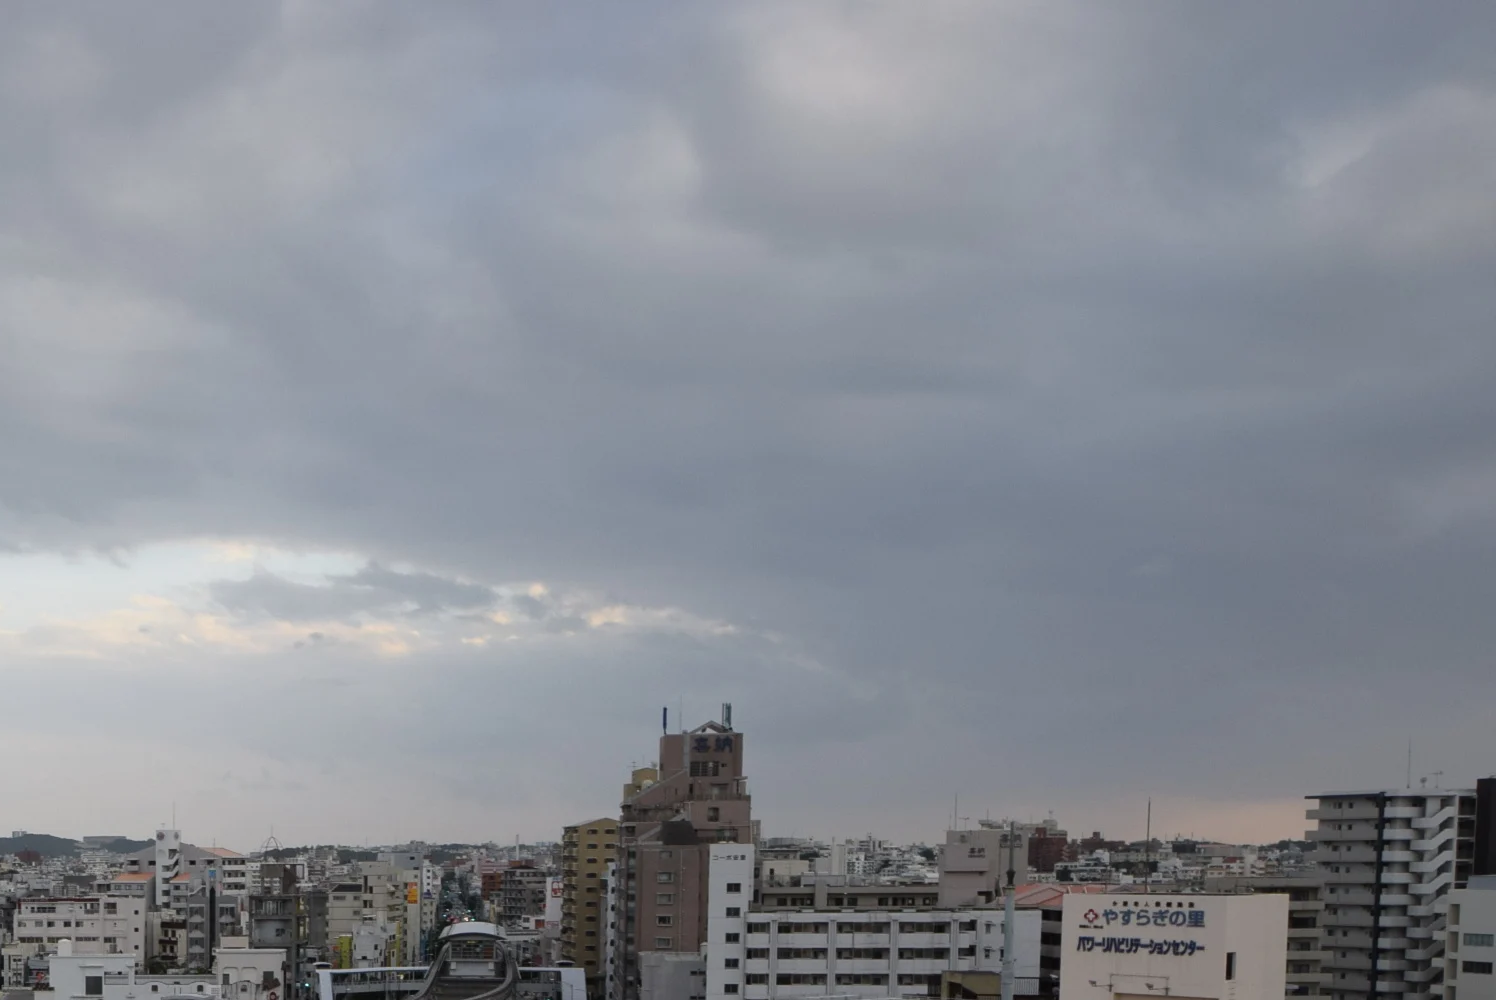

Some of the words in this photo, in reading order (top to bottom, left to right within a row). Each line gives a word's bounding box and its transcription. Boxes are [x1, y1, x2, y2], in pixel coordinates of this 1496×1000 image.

[1102, 909, 1206, 928] やすらぎの里
[1077, 936, 1205, 956] パワーリハビリテーションセンター
